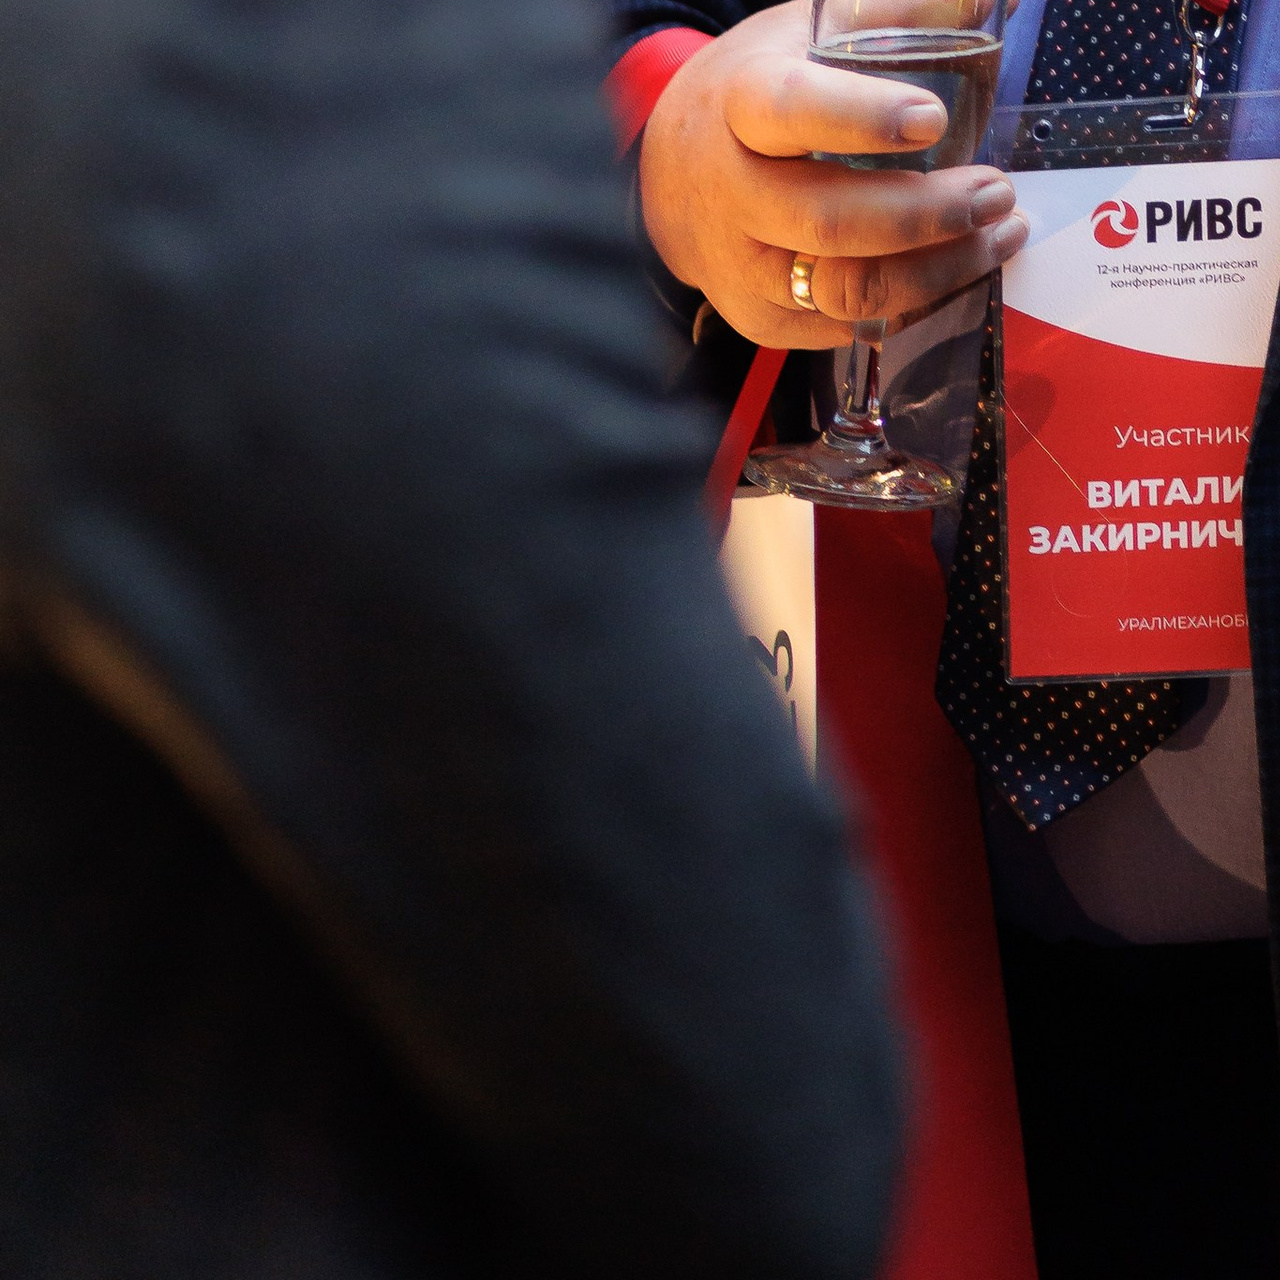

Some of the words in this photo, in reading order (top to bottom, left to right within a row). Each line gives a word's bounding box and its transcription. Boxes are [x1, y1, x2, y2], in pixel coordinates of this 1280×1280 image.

[1145, 197, 1263, 243] РИВС
[1097, 263, 1119, 274] 12-я
[1123, 259, 1258, 276] Научно-практическая
[1110, 275, 1196, 289] конференция
[1199, 273, 1246, 286] «РИВС»
[1114, 425, 1250, 449] Участник
[1028, 519, 1244, 555] ЗАКИРНИЧ
[1117, 614, 1249, 632] УРАЛМЕХАНОБ
